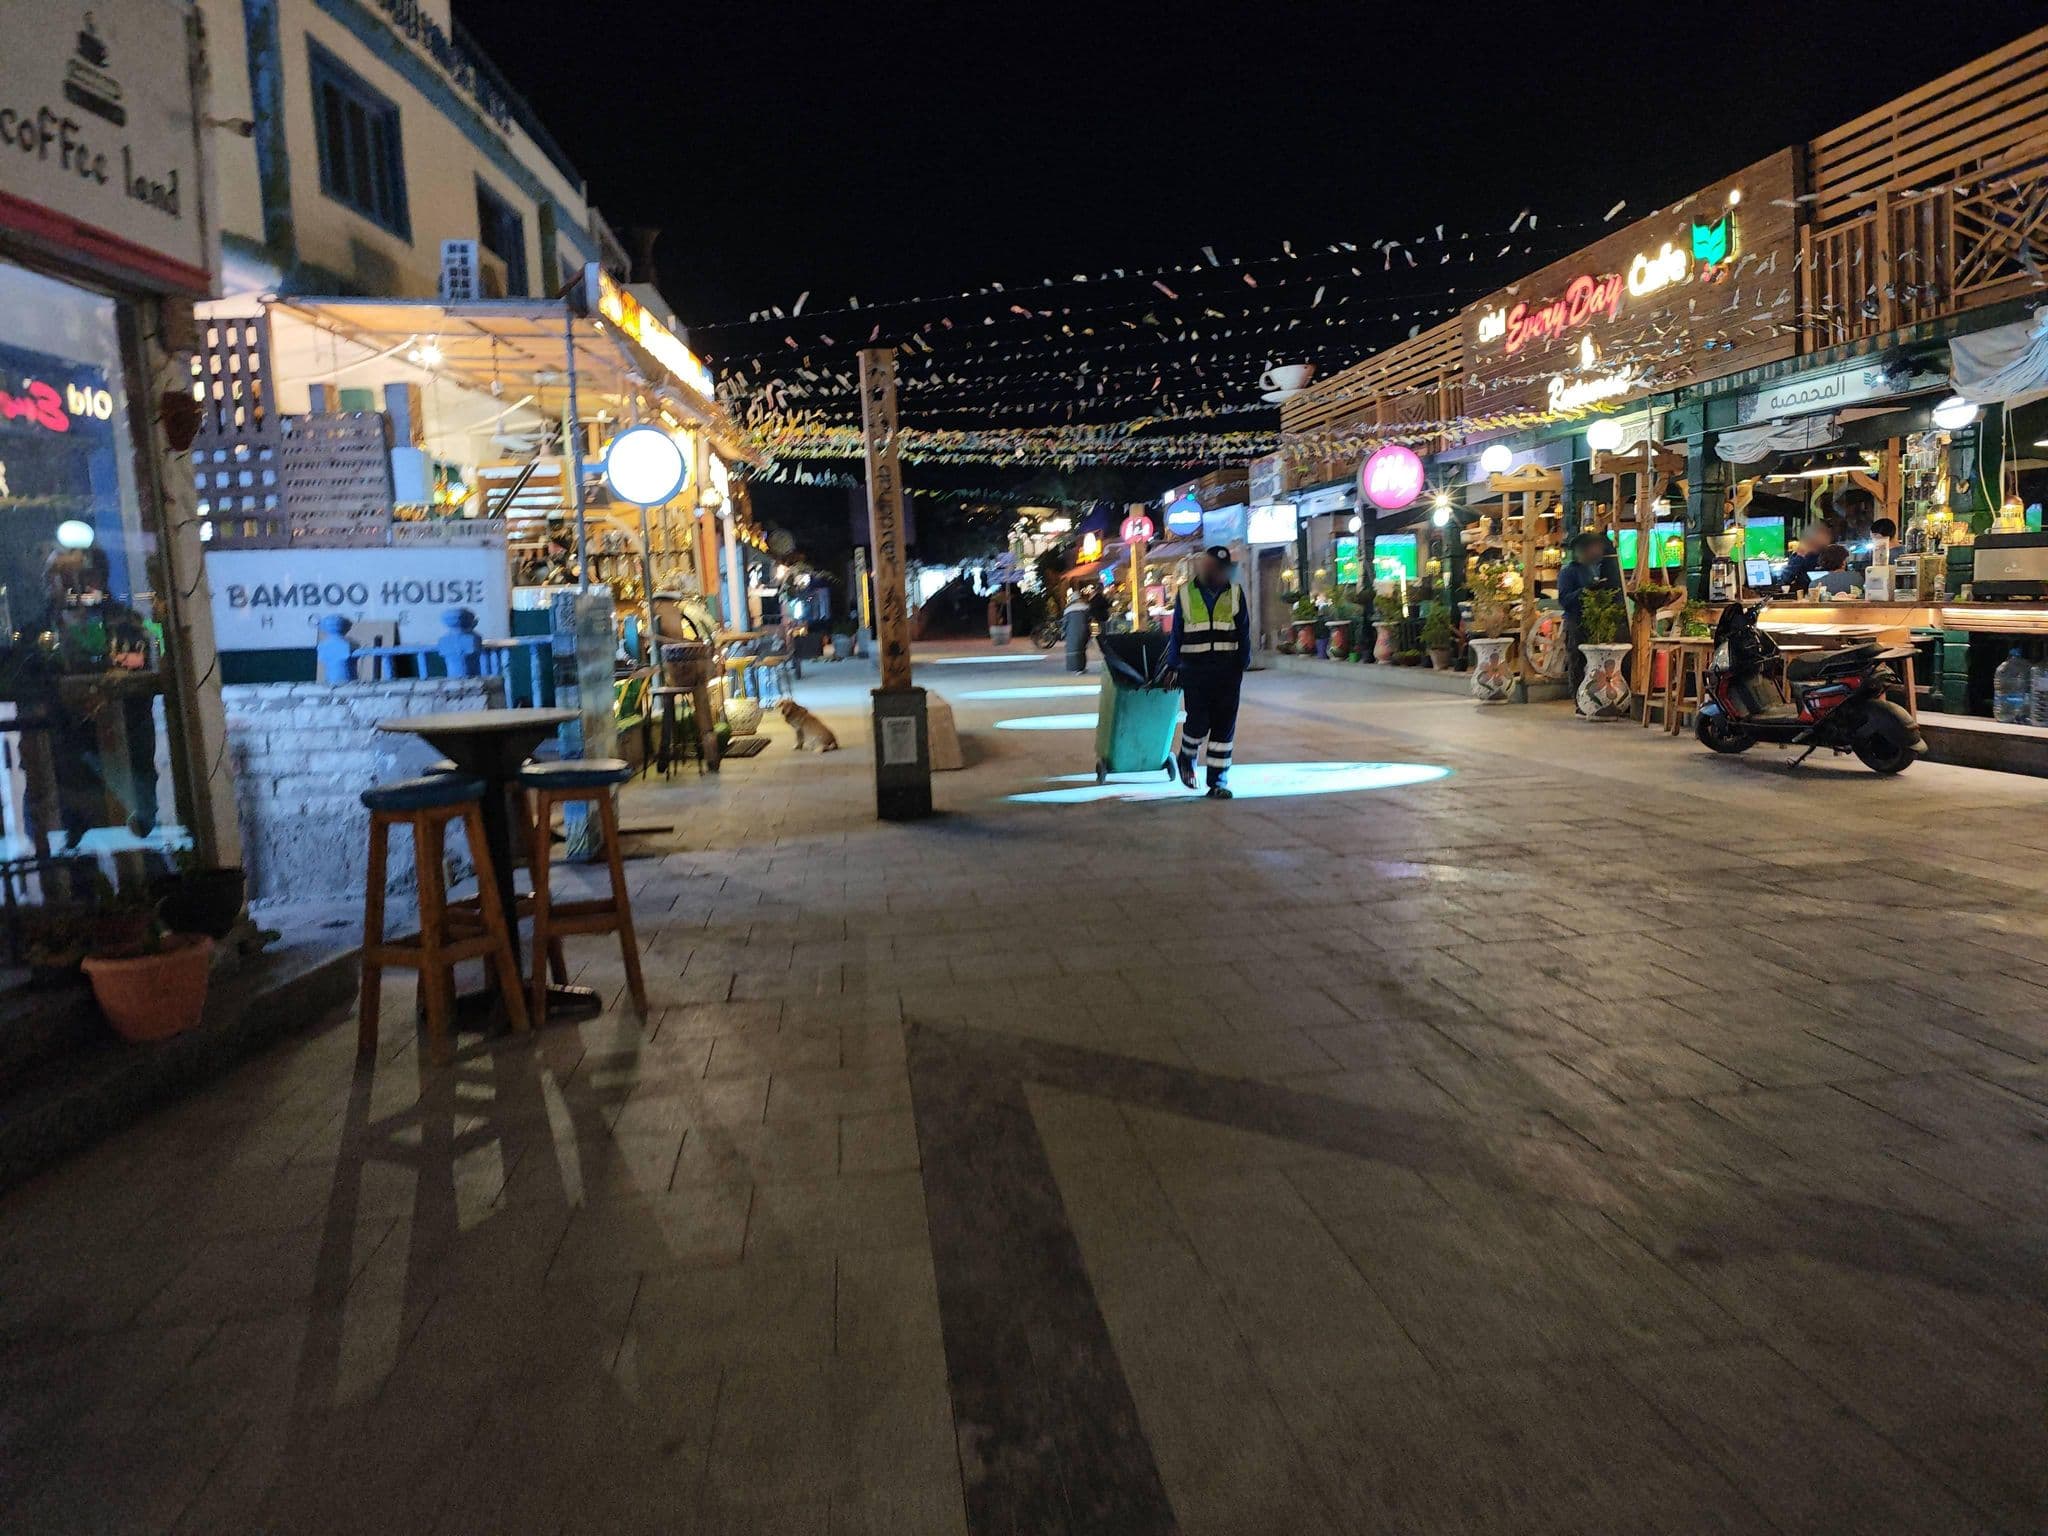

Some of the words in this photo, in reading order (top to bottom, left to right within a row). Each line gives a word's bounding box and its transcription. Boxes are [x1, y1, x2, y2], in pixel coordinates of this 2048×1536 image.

[1504, 302, 1568, 354] Every
[1565, 273, 1625, 328] Day
[226, 581, 370, 609] BAMBOO
[380, 579, 486, 606] HOUSE
